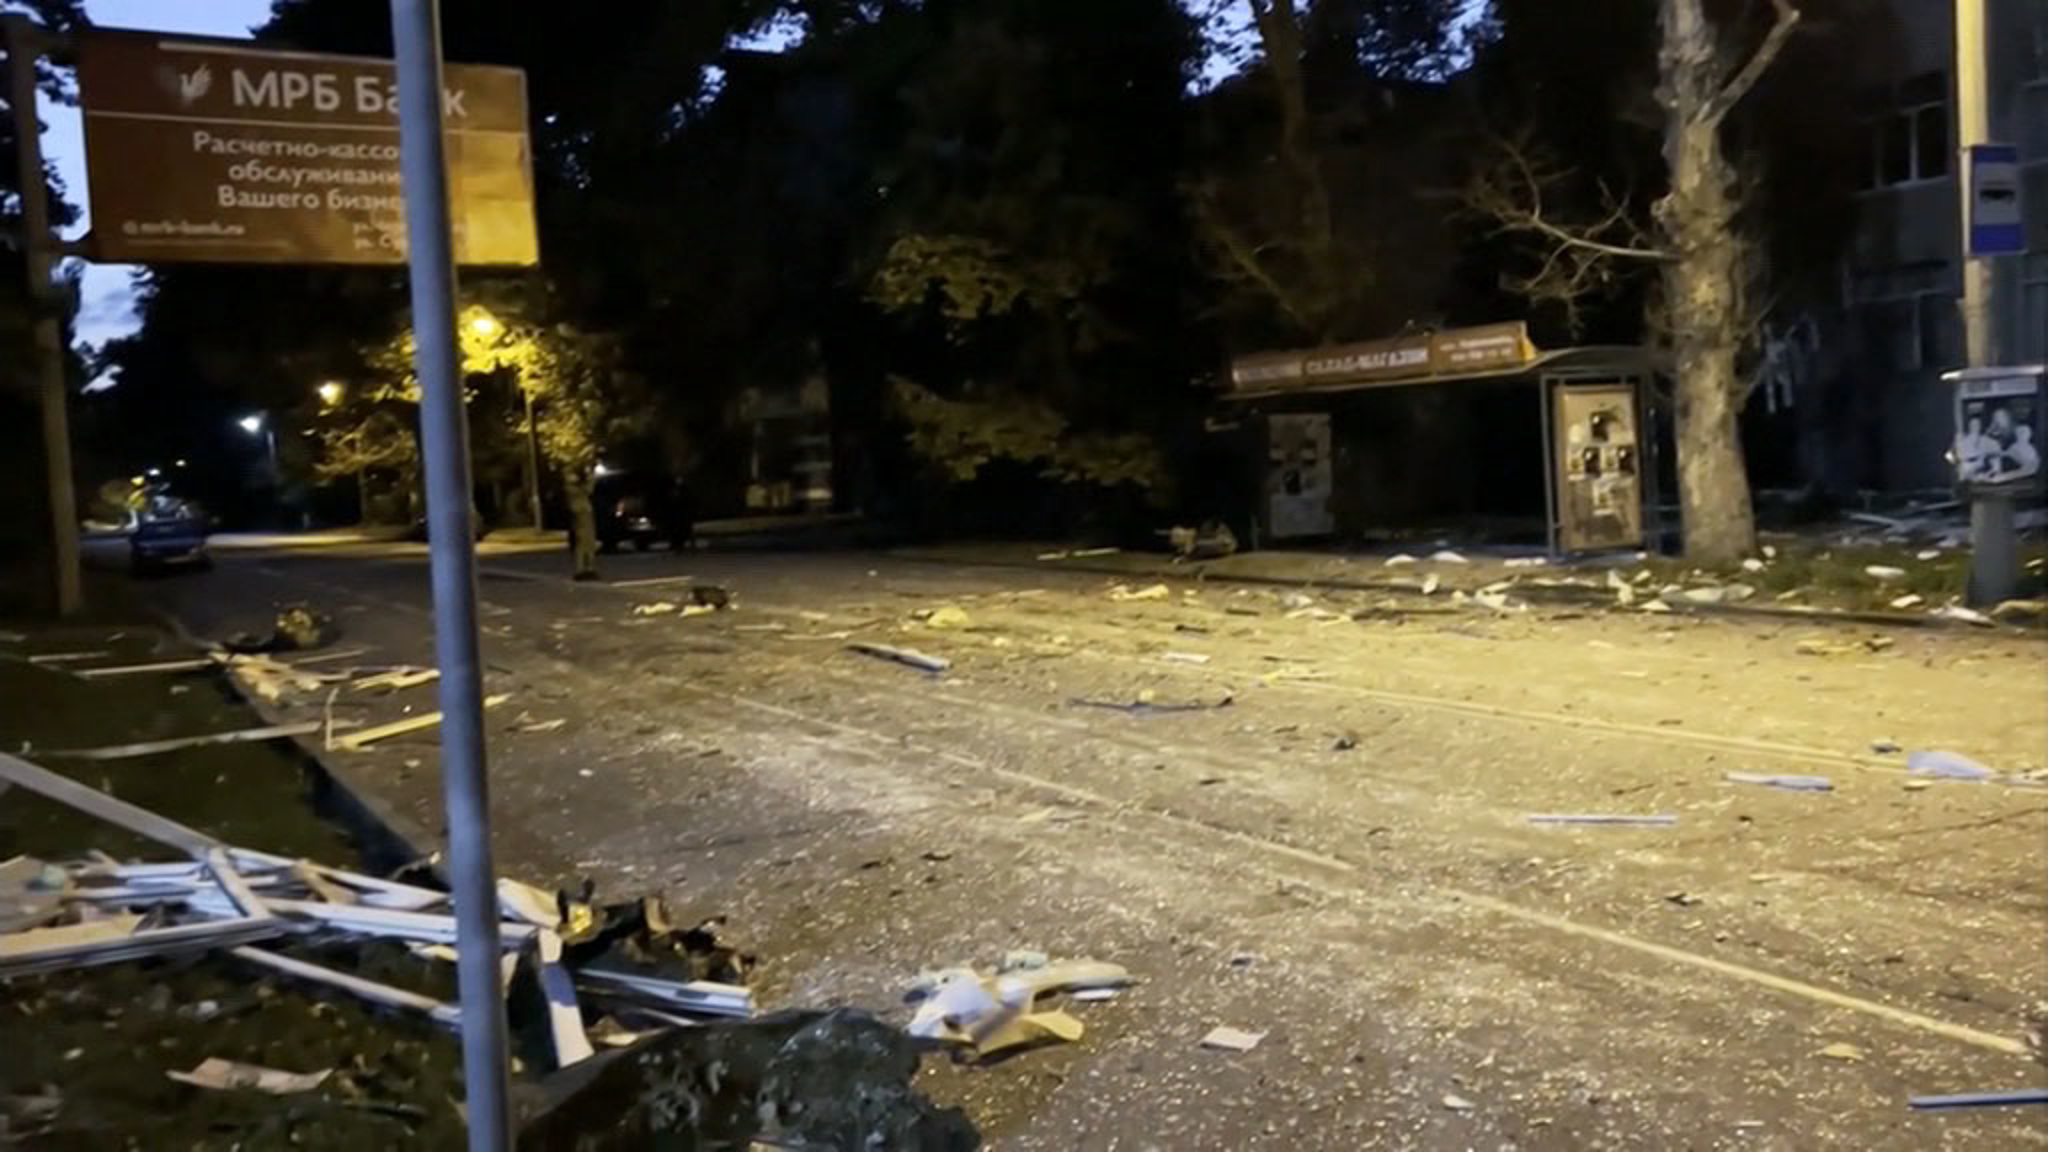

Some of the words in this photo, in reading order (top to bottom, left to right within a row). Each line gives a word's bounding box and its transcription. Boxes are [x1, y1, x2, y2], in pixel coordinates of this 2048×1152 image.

[231, 69, 341, 112] МРБ
[354, 75, 468, 118] Бак
[192, 130, 400, 160] Расчетно-кассо
[228, 160, 405, 187] обслуживани
[217, 184, 320, 209] Вашего
[326, 188, 406, 210] бизне
